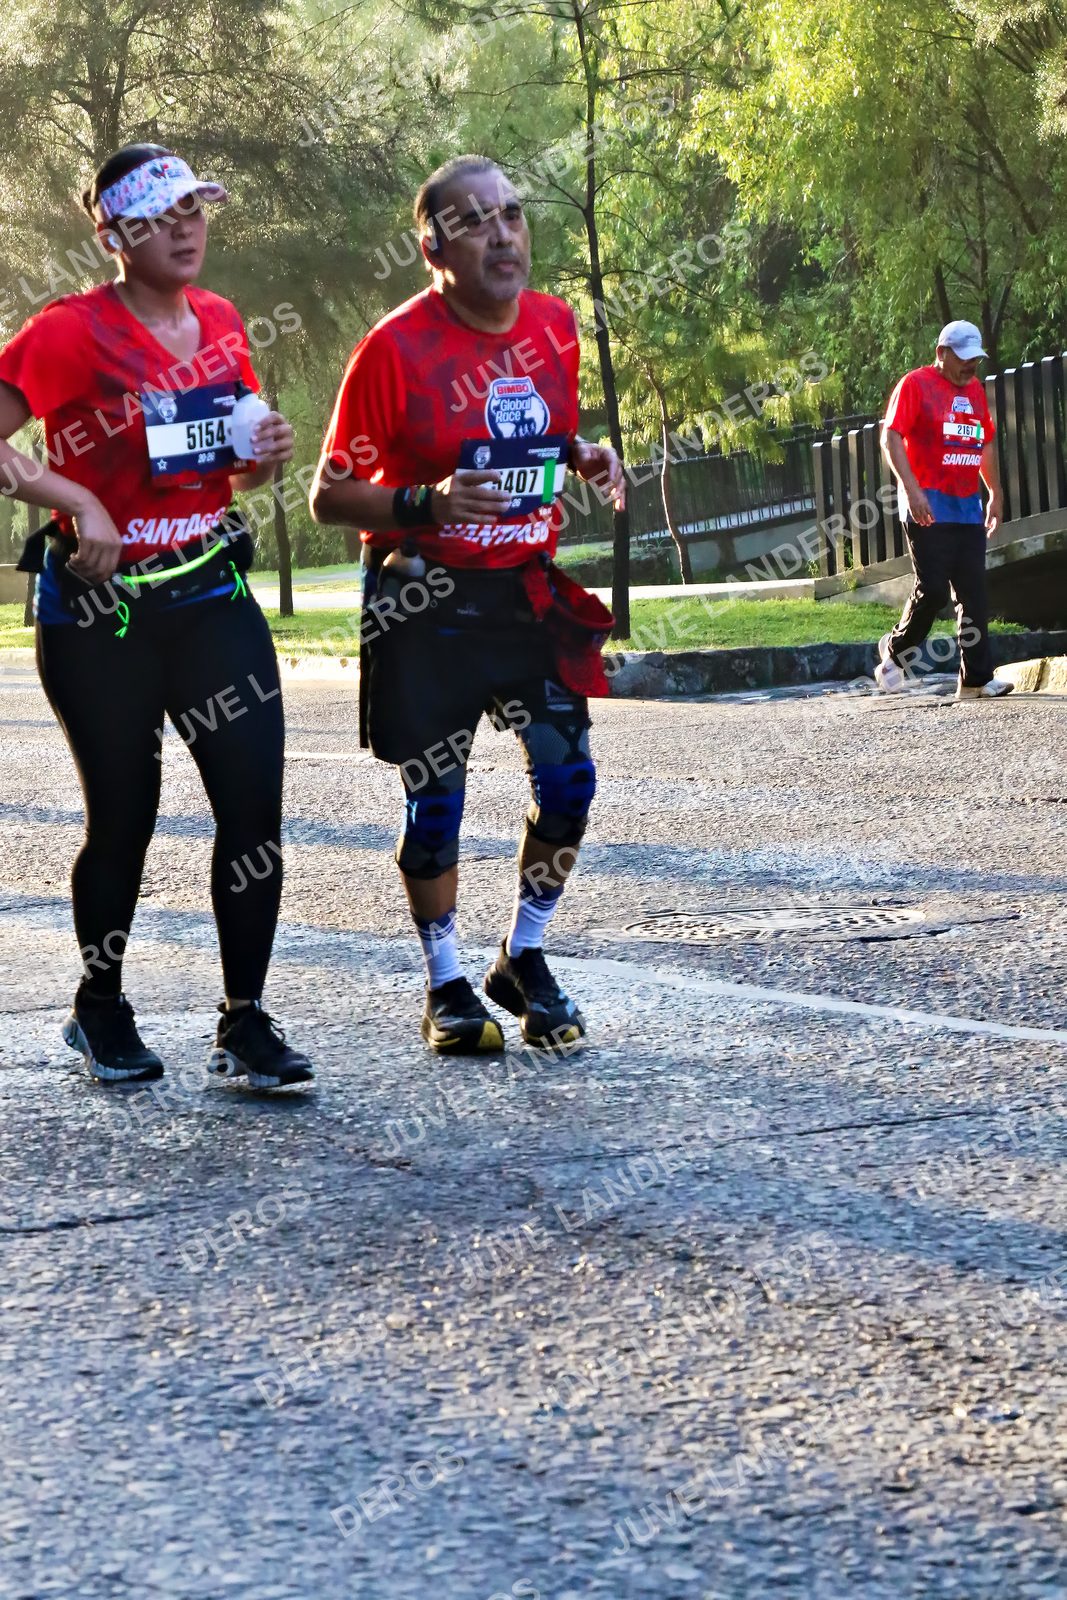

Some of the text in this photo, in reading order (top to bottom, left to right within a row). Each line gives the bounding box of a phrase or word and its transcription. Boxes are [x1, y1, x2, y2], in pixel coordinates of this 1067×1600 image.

[497, 385, 529, 395] BIMBO
[500, 397, 531, 410] Global
[495, 410, 521, 423] Race
[186, 419, 226, 450] 5154
[957, 424, 974, 436] 2167
